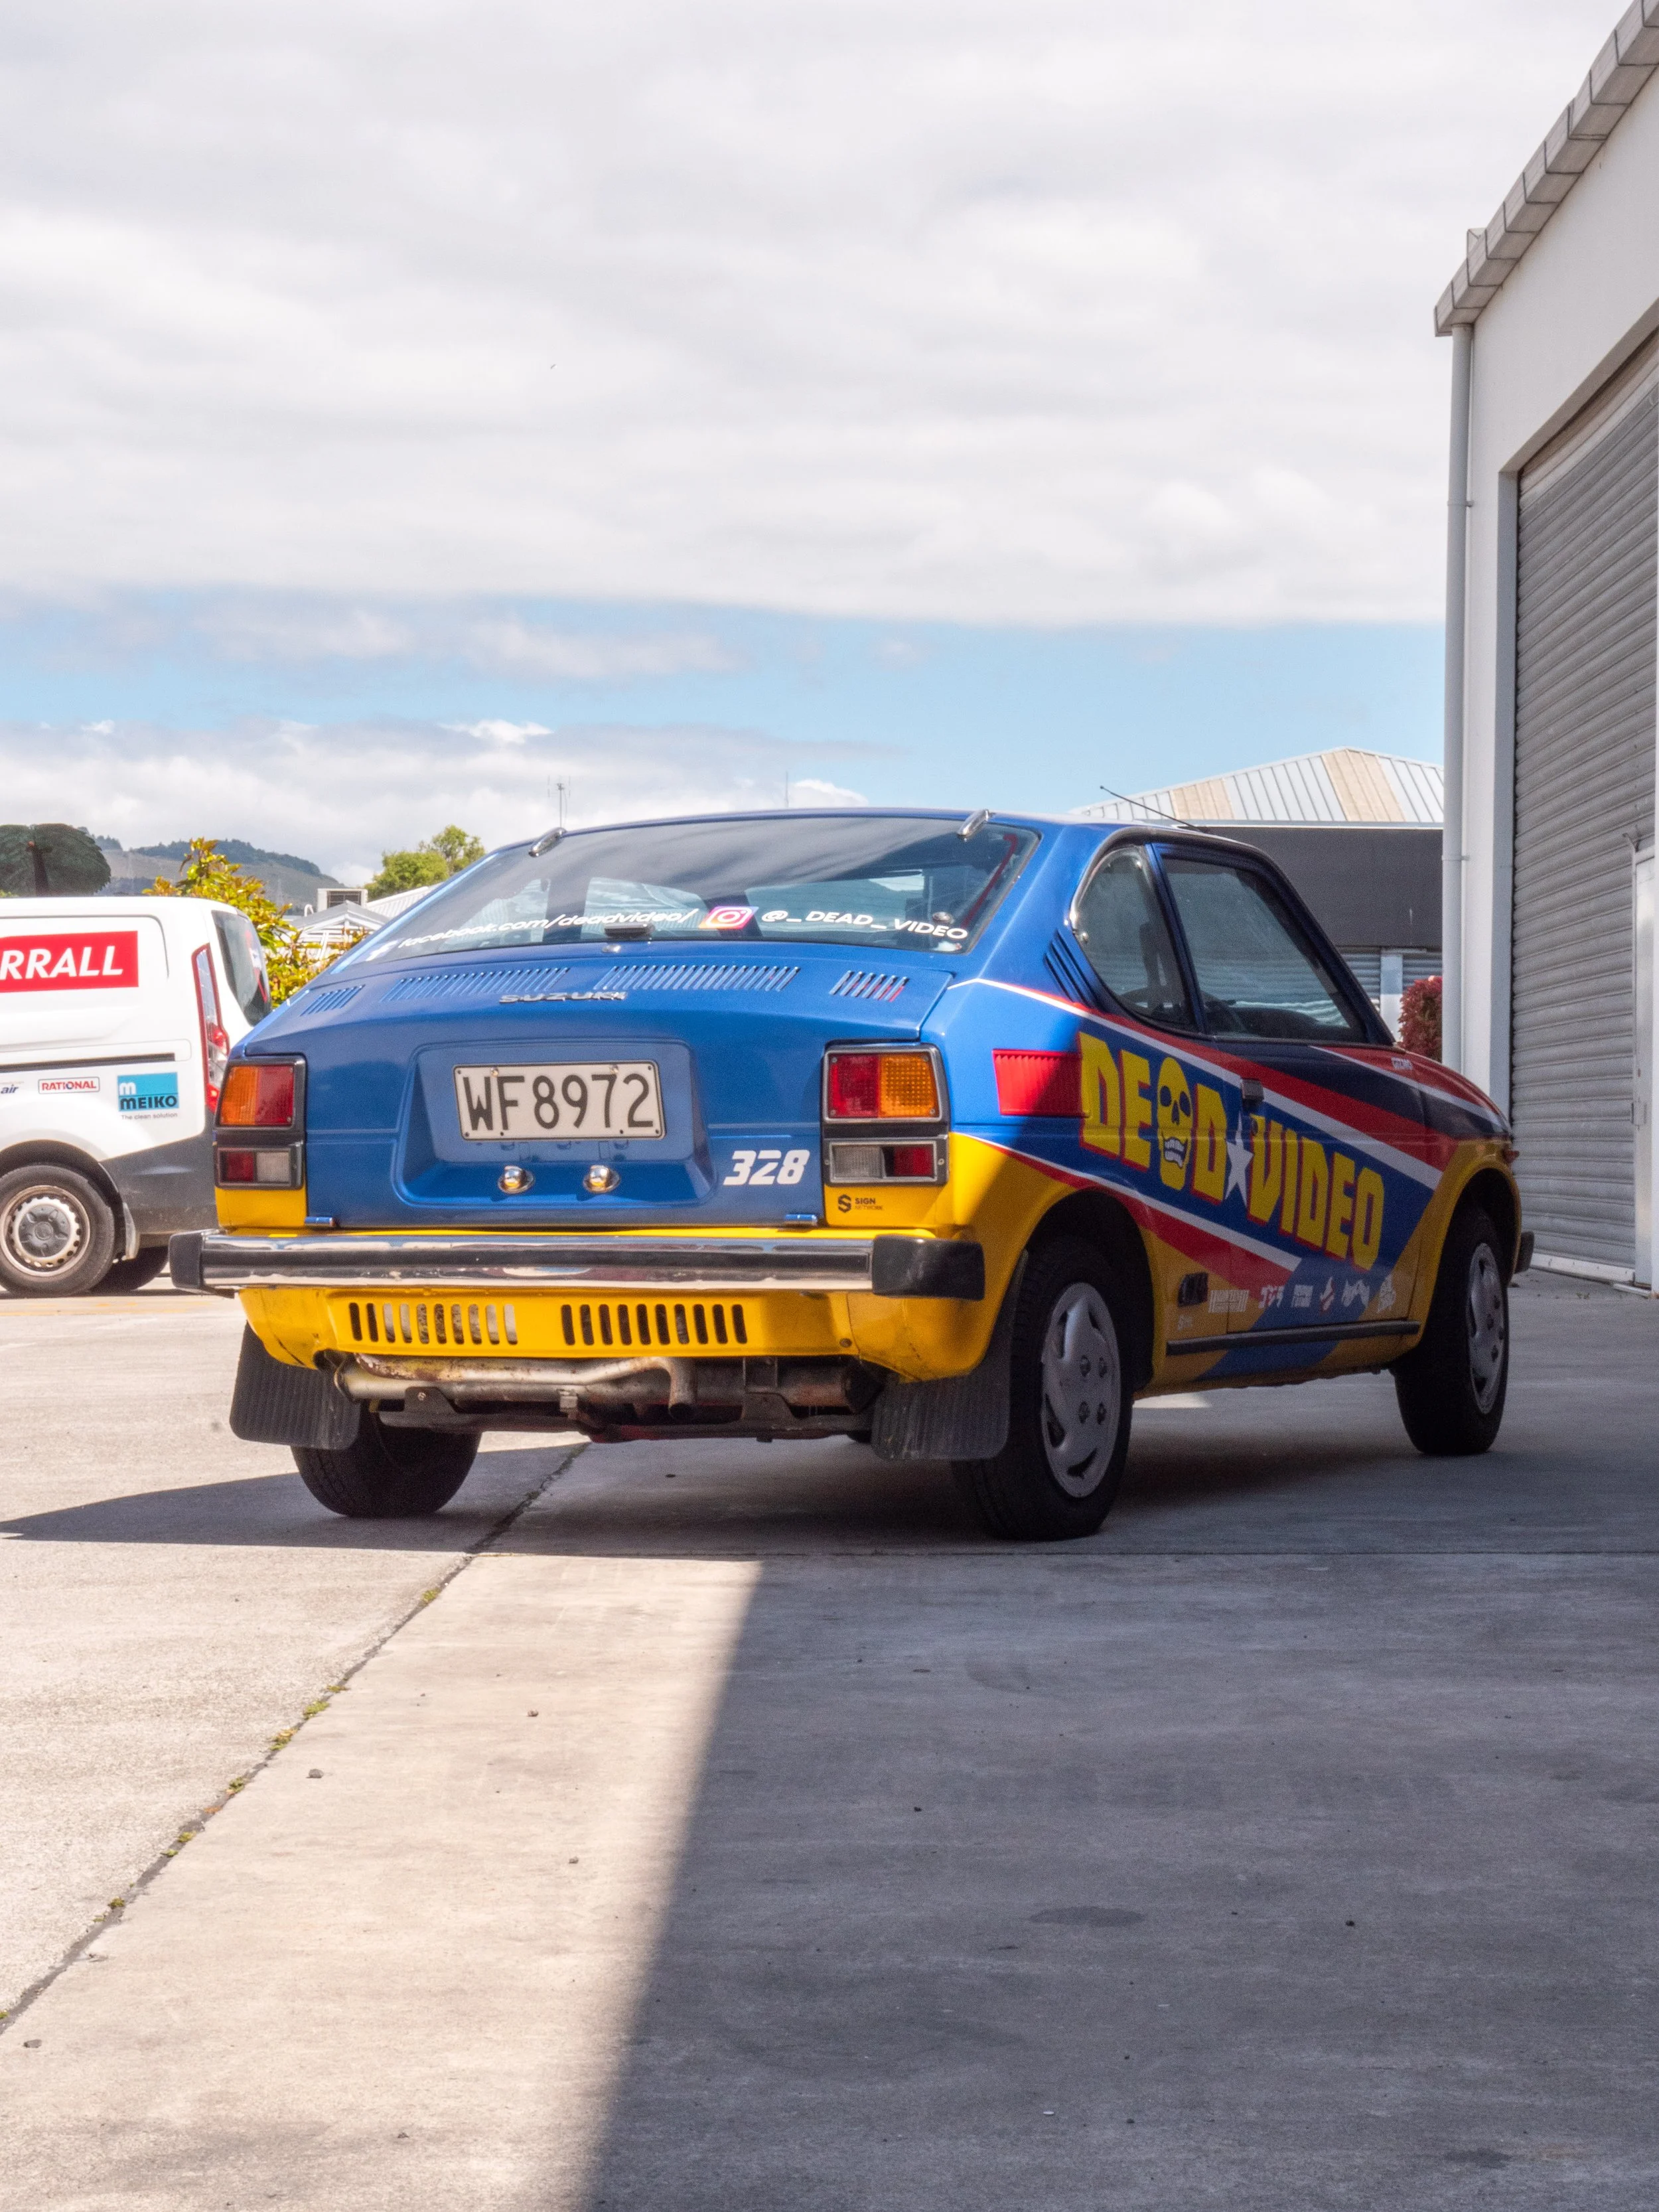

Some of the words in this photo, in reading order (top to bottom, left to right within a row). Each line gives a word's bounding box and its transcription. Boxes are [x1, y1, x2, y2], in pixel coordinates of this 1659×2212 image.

[398, 909, 699, 948] facebook.com/deadvideo/
[0, 946, 123, 980] RRALL
[499, 992, 628, 1003] SUZUKI
[1, 1084, 19, 1094] air
[42, 1080, 97, 1091] RATIONAL
[463, 1073, 654, 1131] WF8972
[723, 1149, 811, 1186] 328
[1078, 1032, 1228, 1207] DED
[1247, 1114, 1385, 1273] VIDEO
